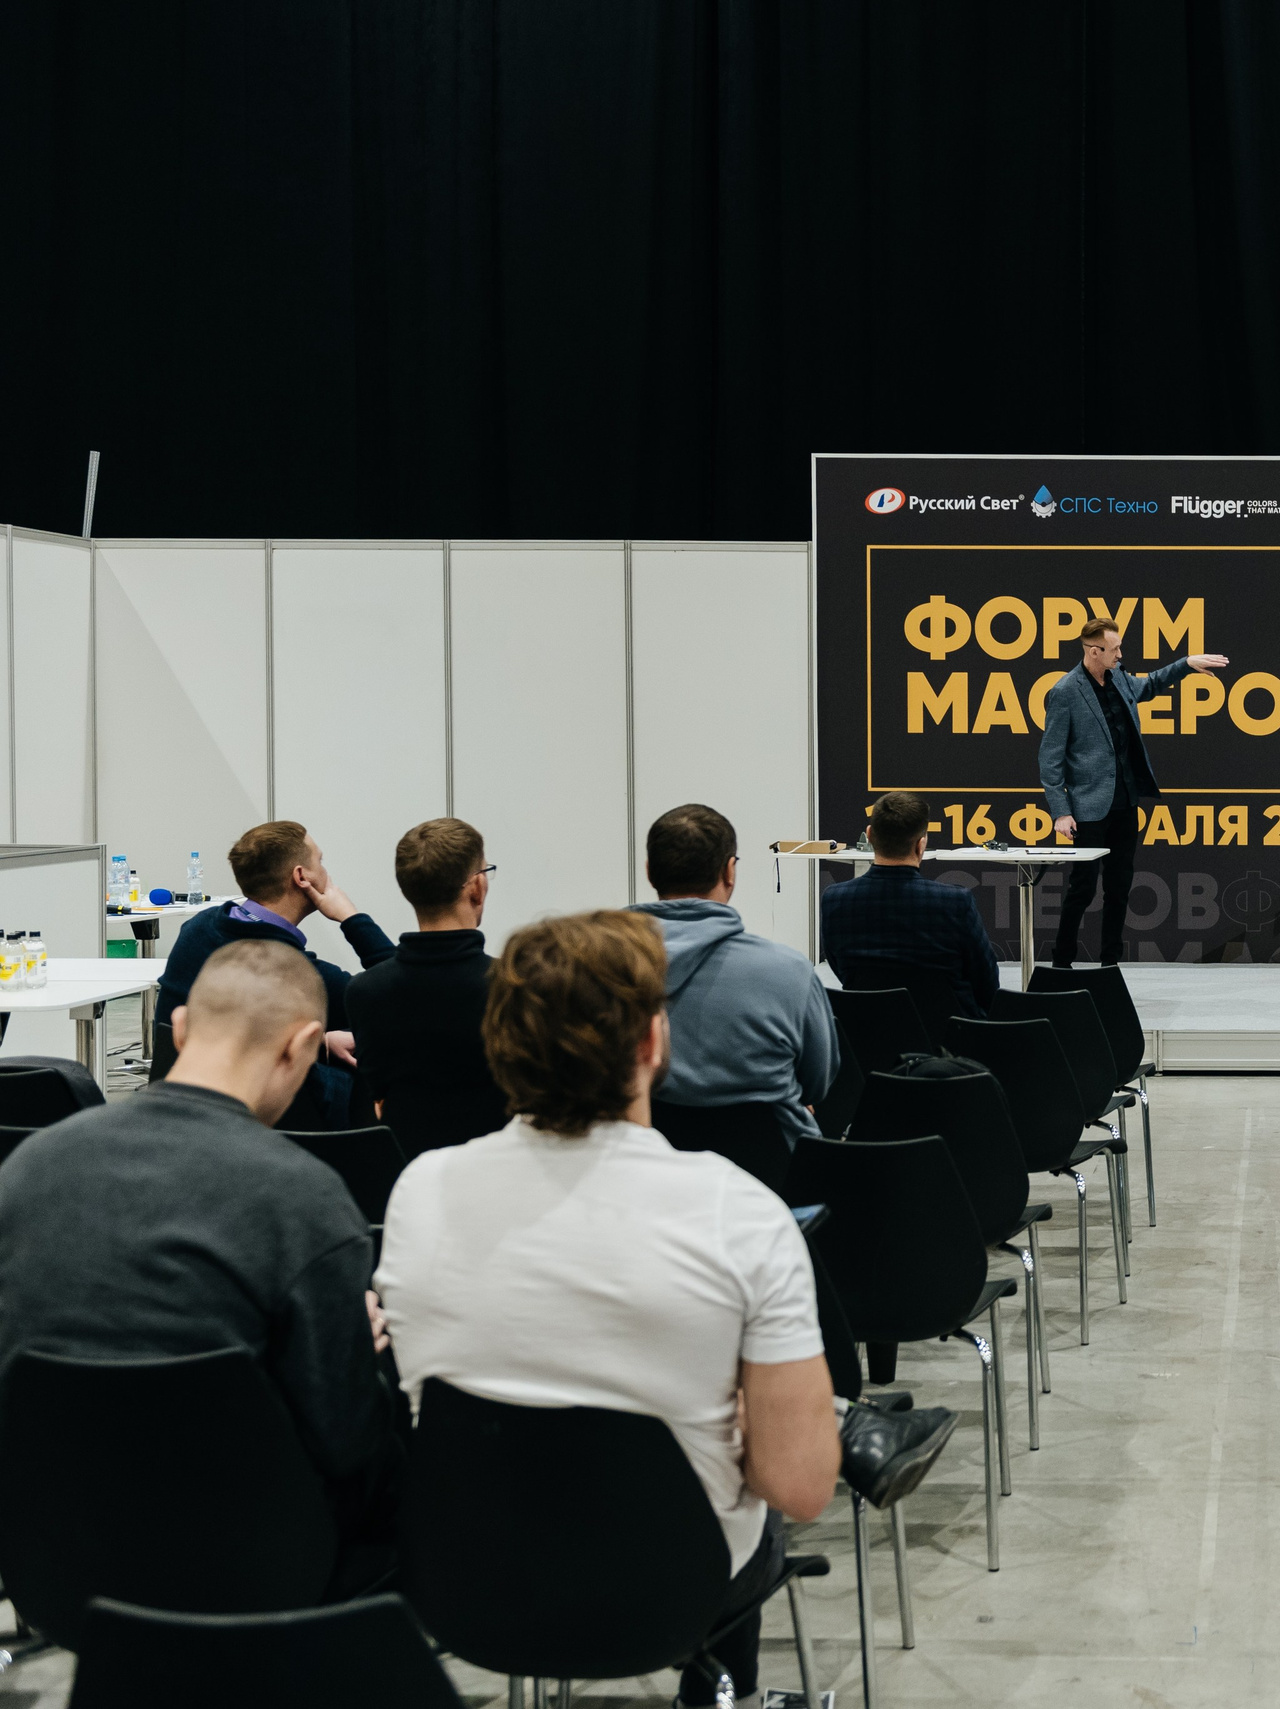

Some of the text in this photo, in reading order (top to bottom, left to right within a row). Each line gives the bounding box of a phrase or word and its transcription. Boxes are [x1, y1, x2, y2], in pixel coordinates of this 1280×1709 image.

[909, 495, 976, 514] Русский
[1059, 497, 1159, 514] СПС Техно
[1171, 496, 1248, 519] Flügger
